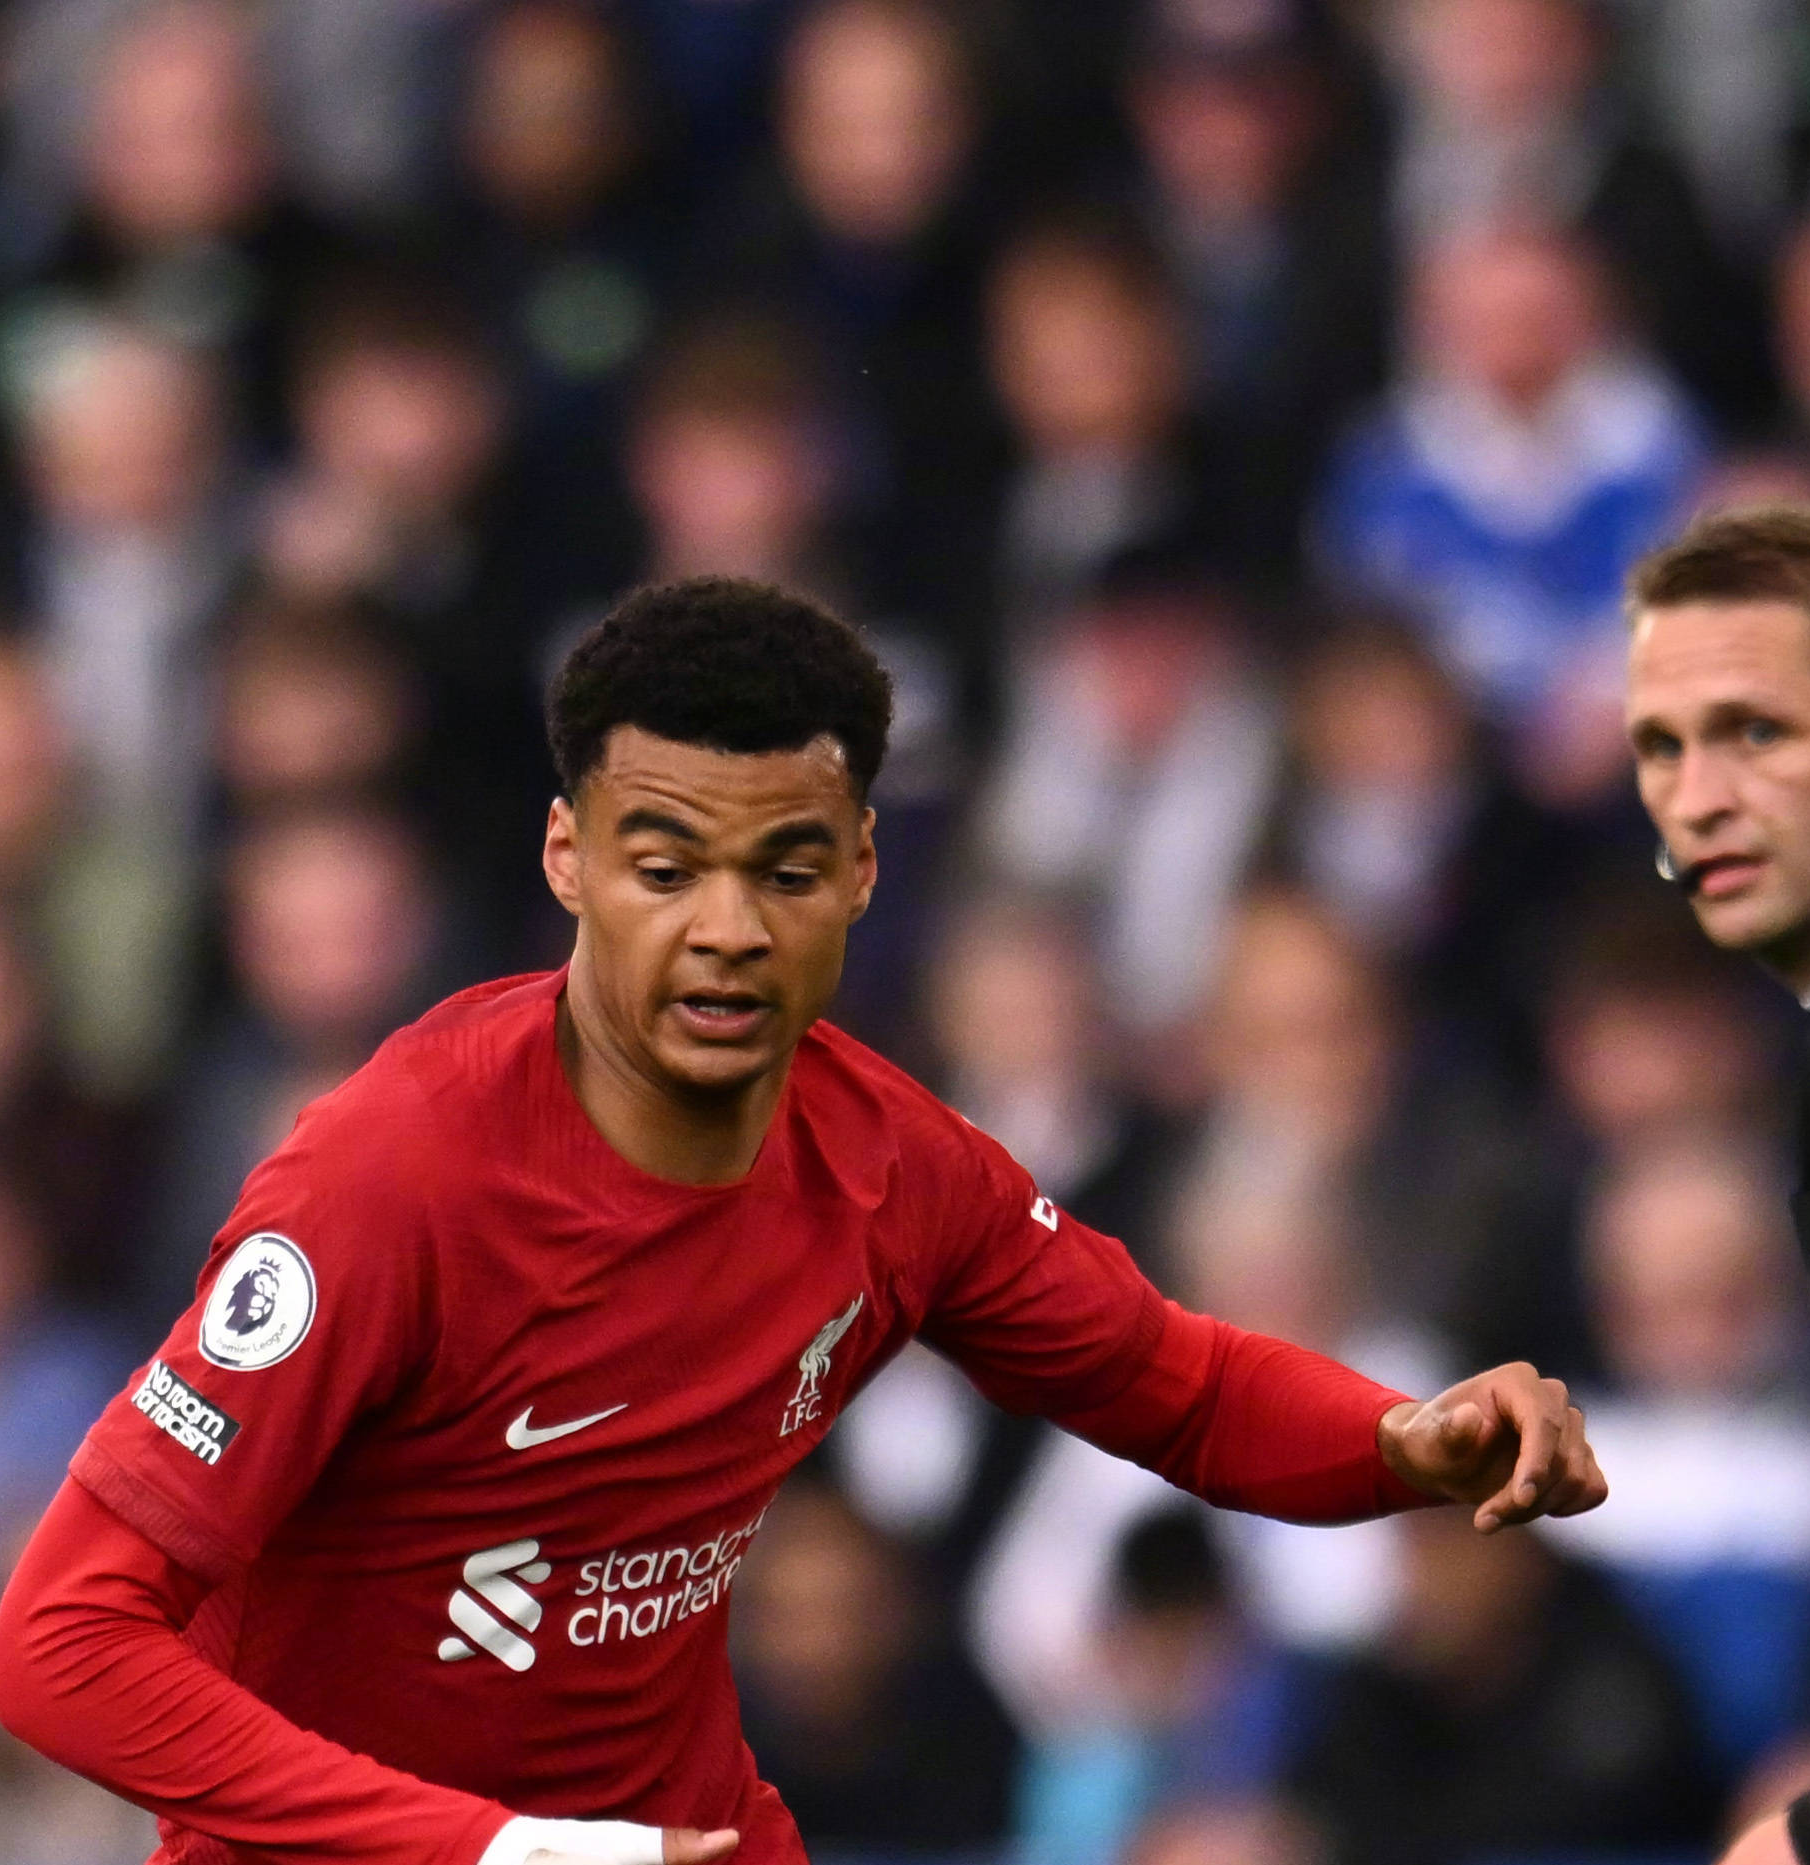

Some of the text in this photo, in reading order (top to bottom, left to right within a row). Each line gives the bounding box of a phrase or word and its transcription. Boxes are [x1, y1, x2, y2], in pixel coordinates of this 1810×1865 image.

[131, 1387, 222, 1467] for racism
[147, 1359, 225, 1440] No room
